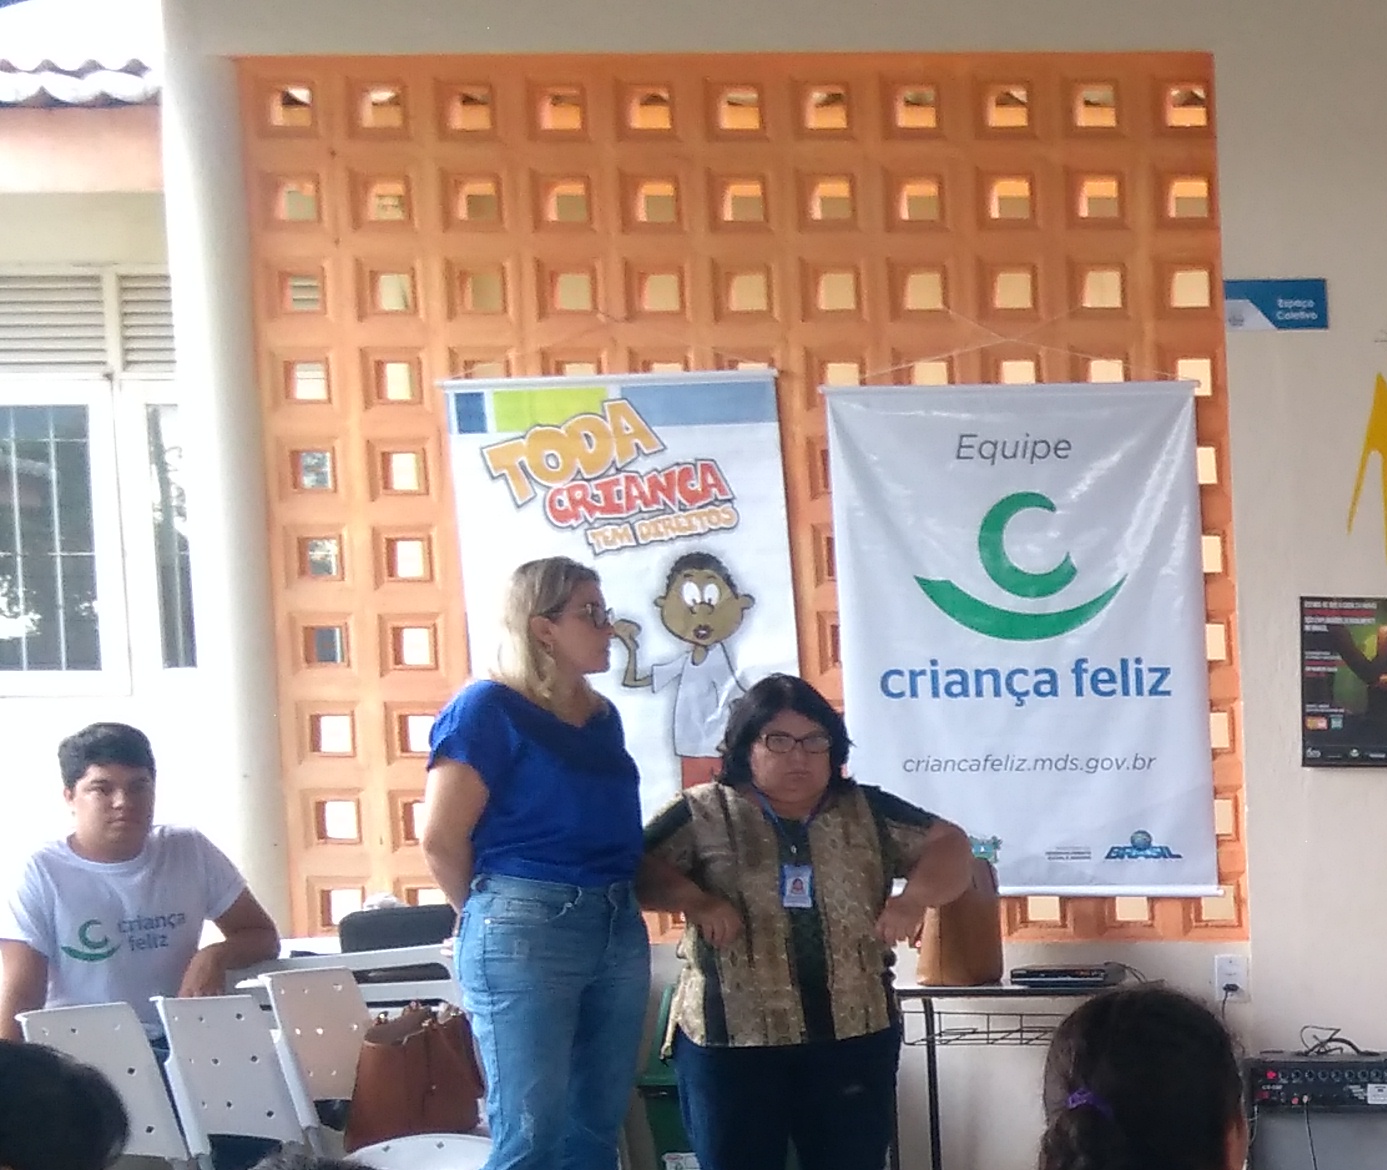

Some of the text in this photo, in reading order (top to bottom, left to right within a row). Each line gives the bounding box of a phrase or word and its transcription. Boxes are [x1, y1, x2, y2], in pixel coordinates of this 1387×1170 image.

[480, 398, 667, 508] TODA
[955, 433, 1072, 466] Equipe
[879, 656, 1173, 707] criança feliz
[902, 752, 1158, 775] criancafeliz.mds.gov.br
[117, 911, 186, 934] criança
[129, 932, 169, 951] feliz
